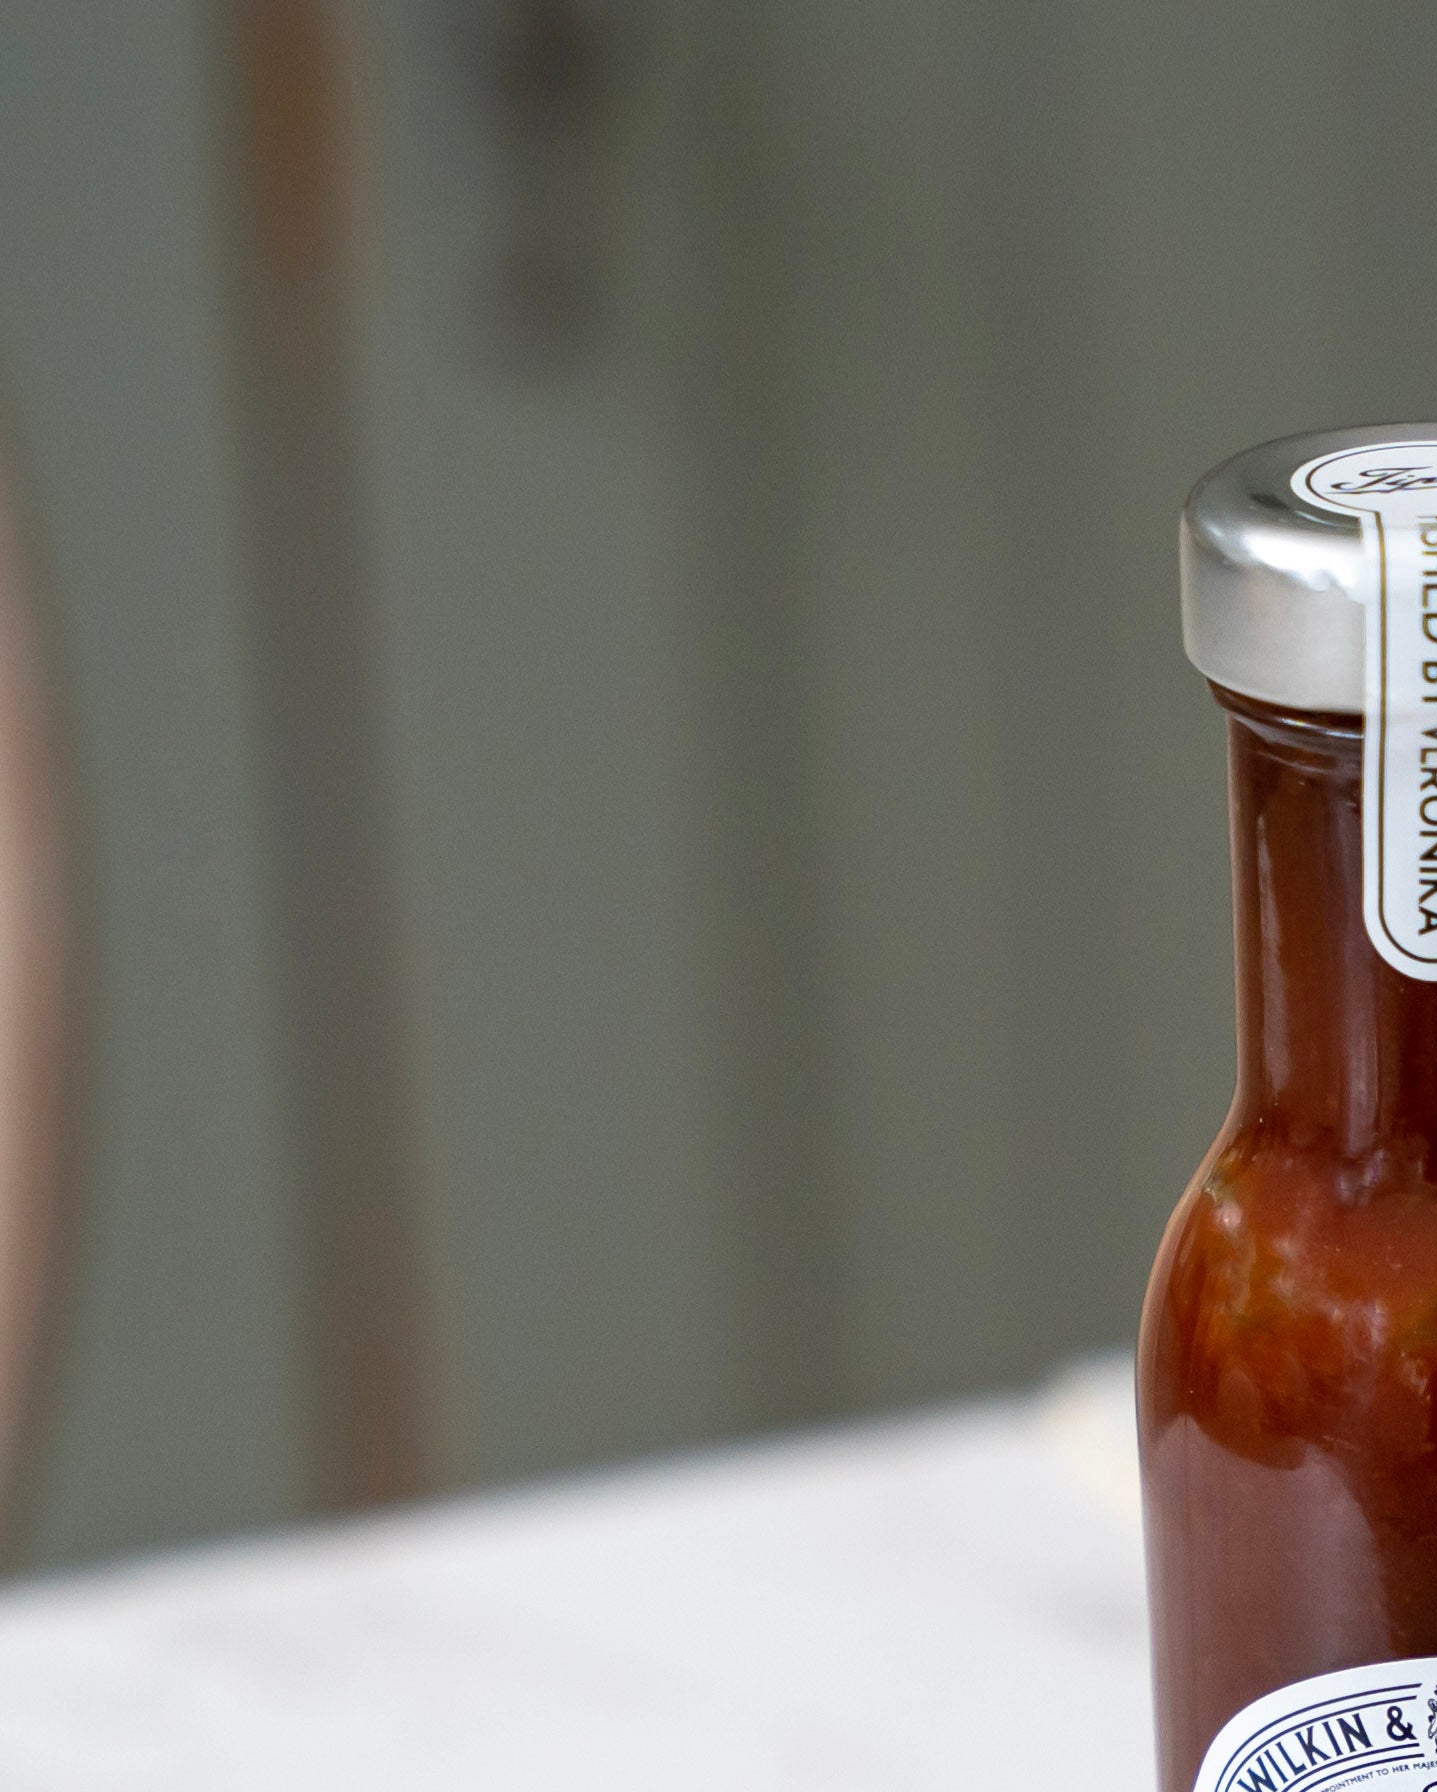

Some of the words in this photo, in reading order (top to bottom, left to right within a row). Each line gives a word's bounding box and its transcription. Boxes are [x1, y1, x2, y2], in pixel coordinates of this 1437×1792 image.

[1387, 1705, 1416, 1741] &
[1376, 1768, 1389, 1777] TO
[1392, 1765, 1410, 1773] HER
